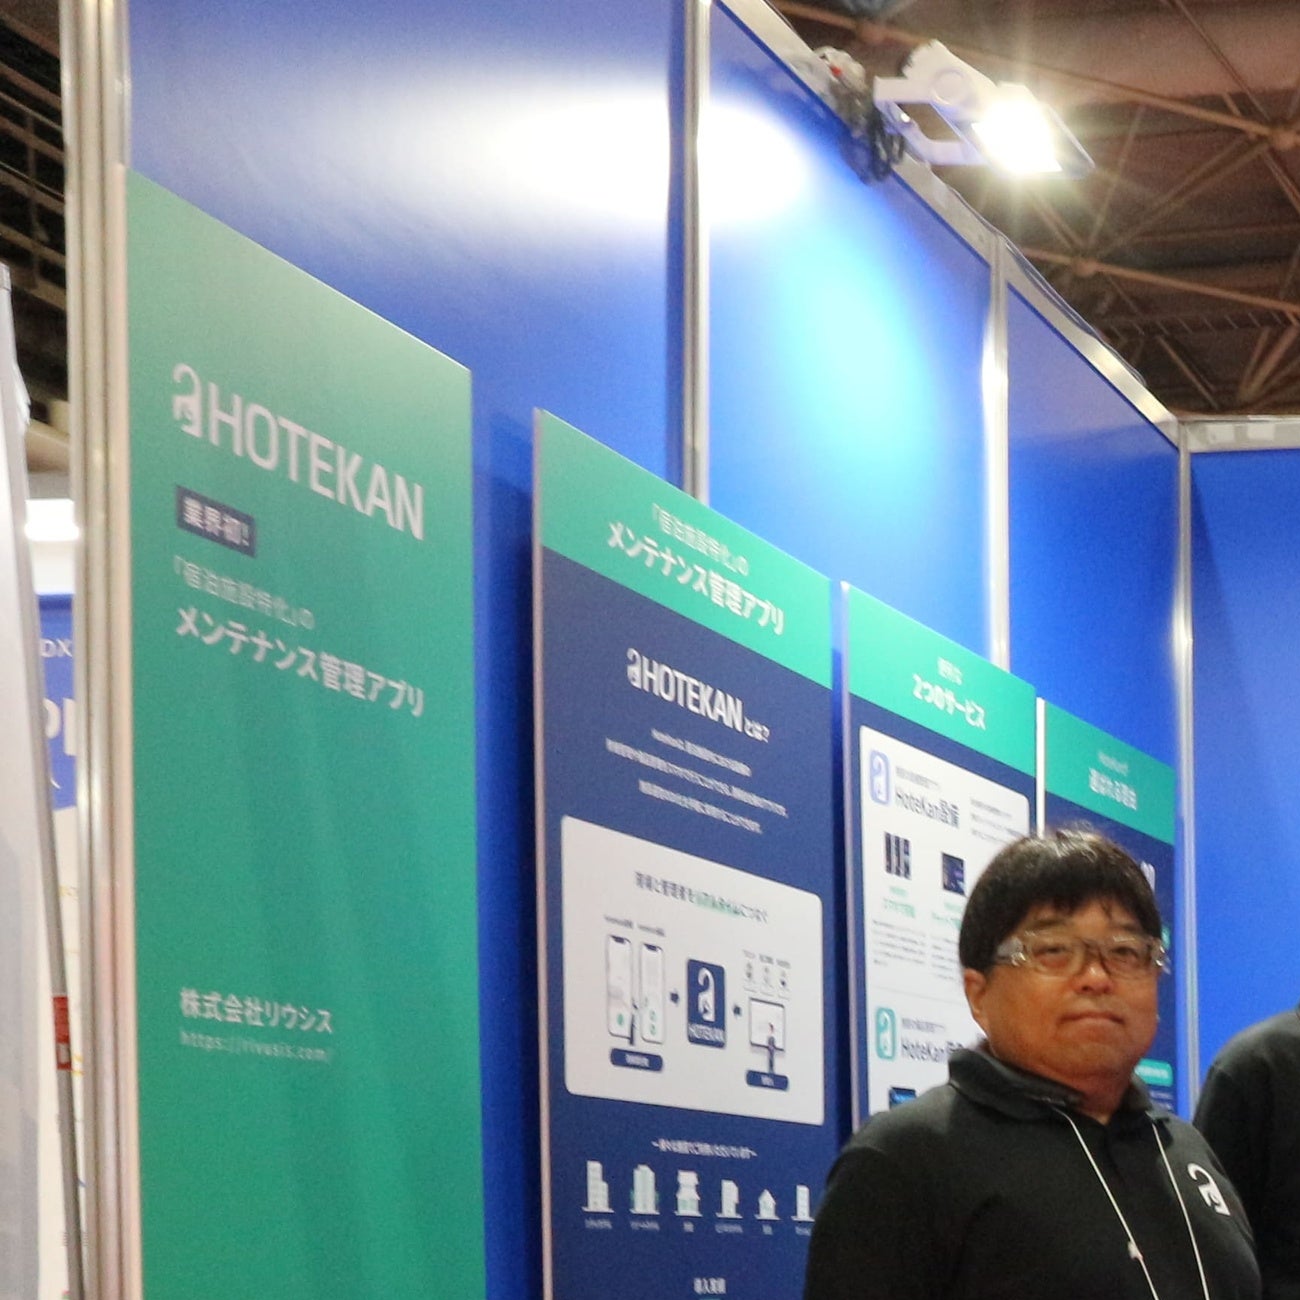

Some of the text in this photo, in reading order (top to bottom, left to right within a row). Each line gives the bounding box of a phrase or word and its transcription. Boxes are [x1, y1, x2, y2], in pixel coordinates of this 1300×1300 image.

[208, 381, 424, 541] HOTEKAN
[606, 520, 784, 636] メンテナンス管理アプリ
[176, 607, 424, 718] メンテナンス管理アプリ
[642, 654, 743, 733] HOTEKAN
